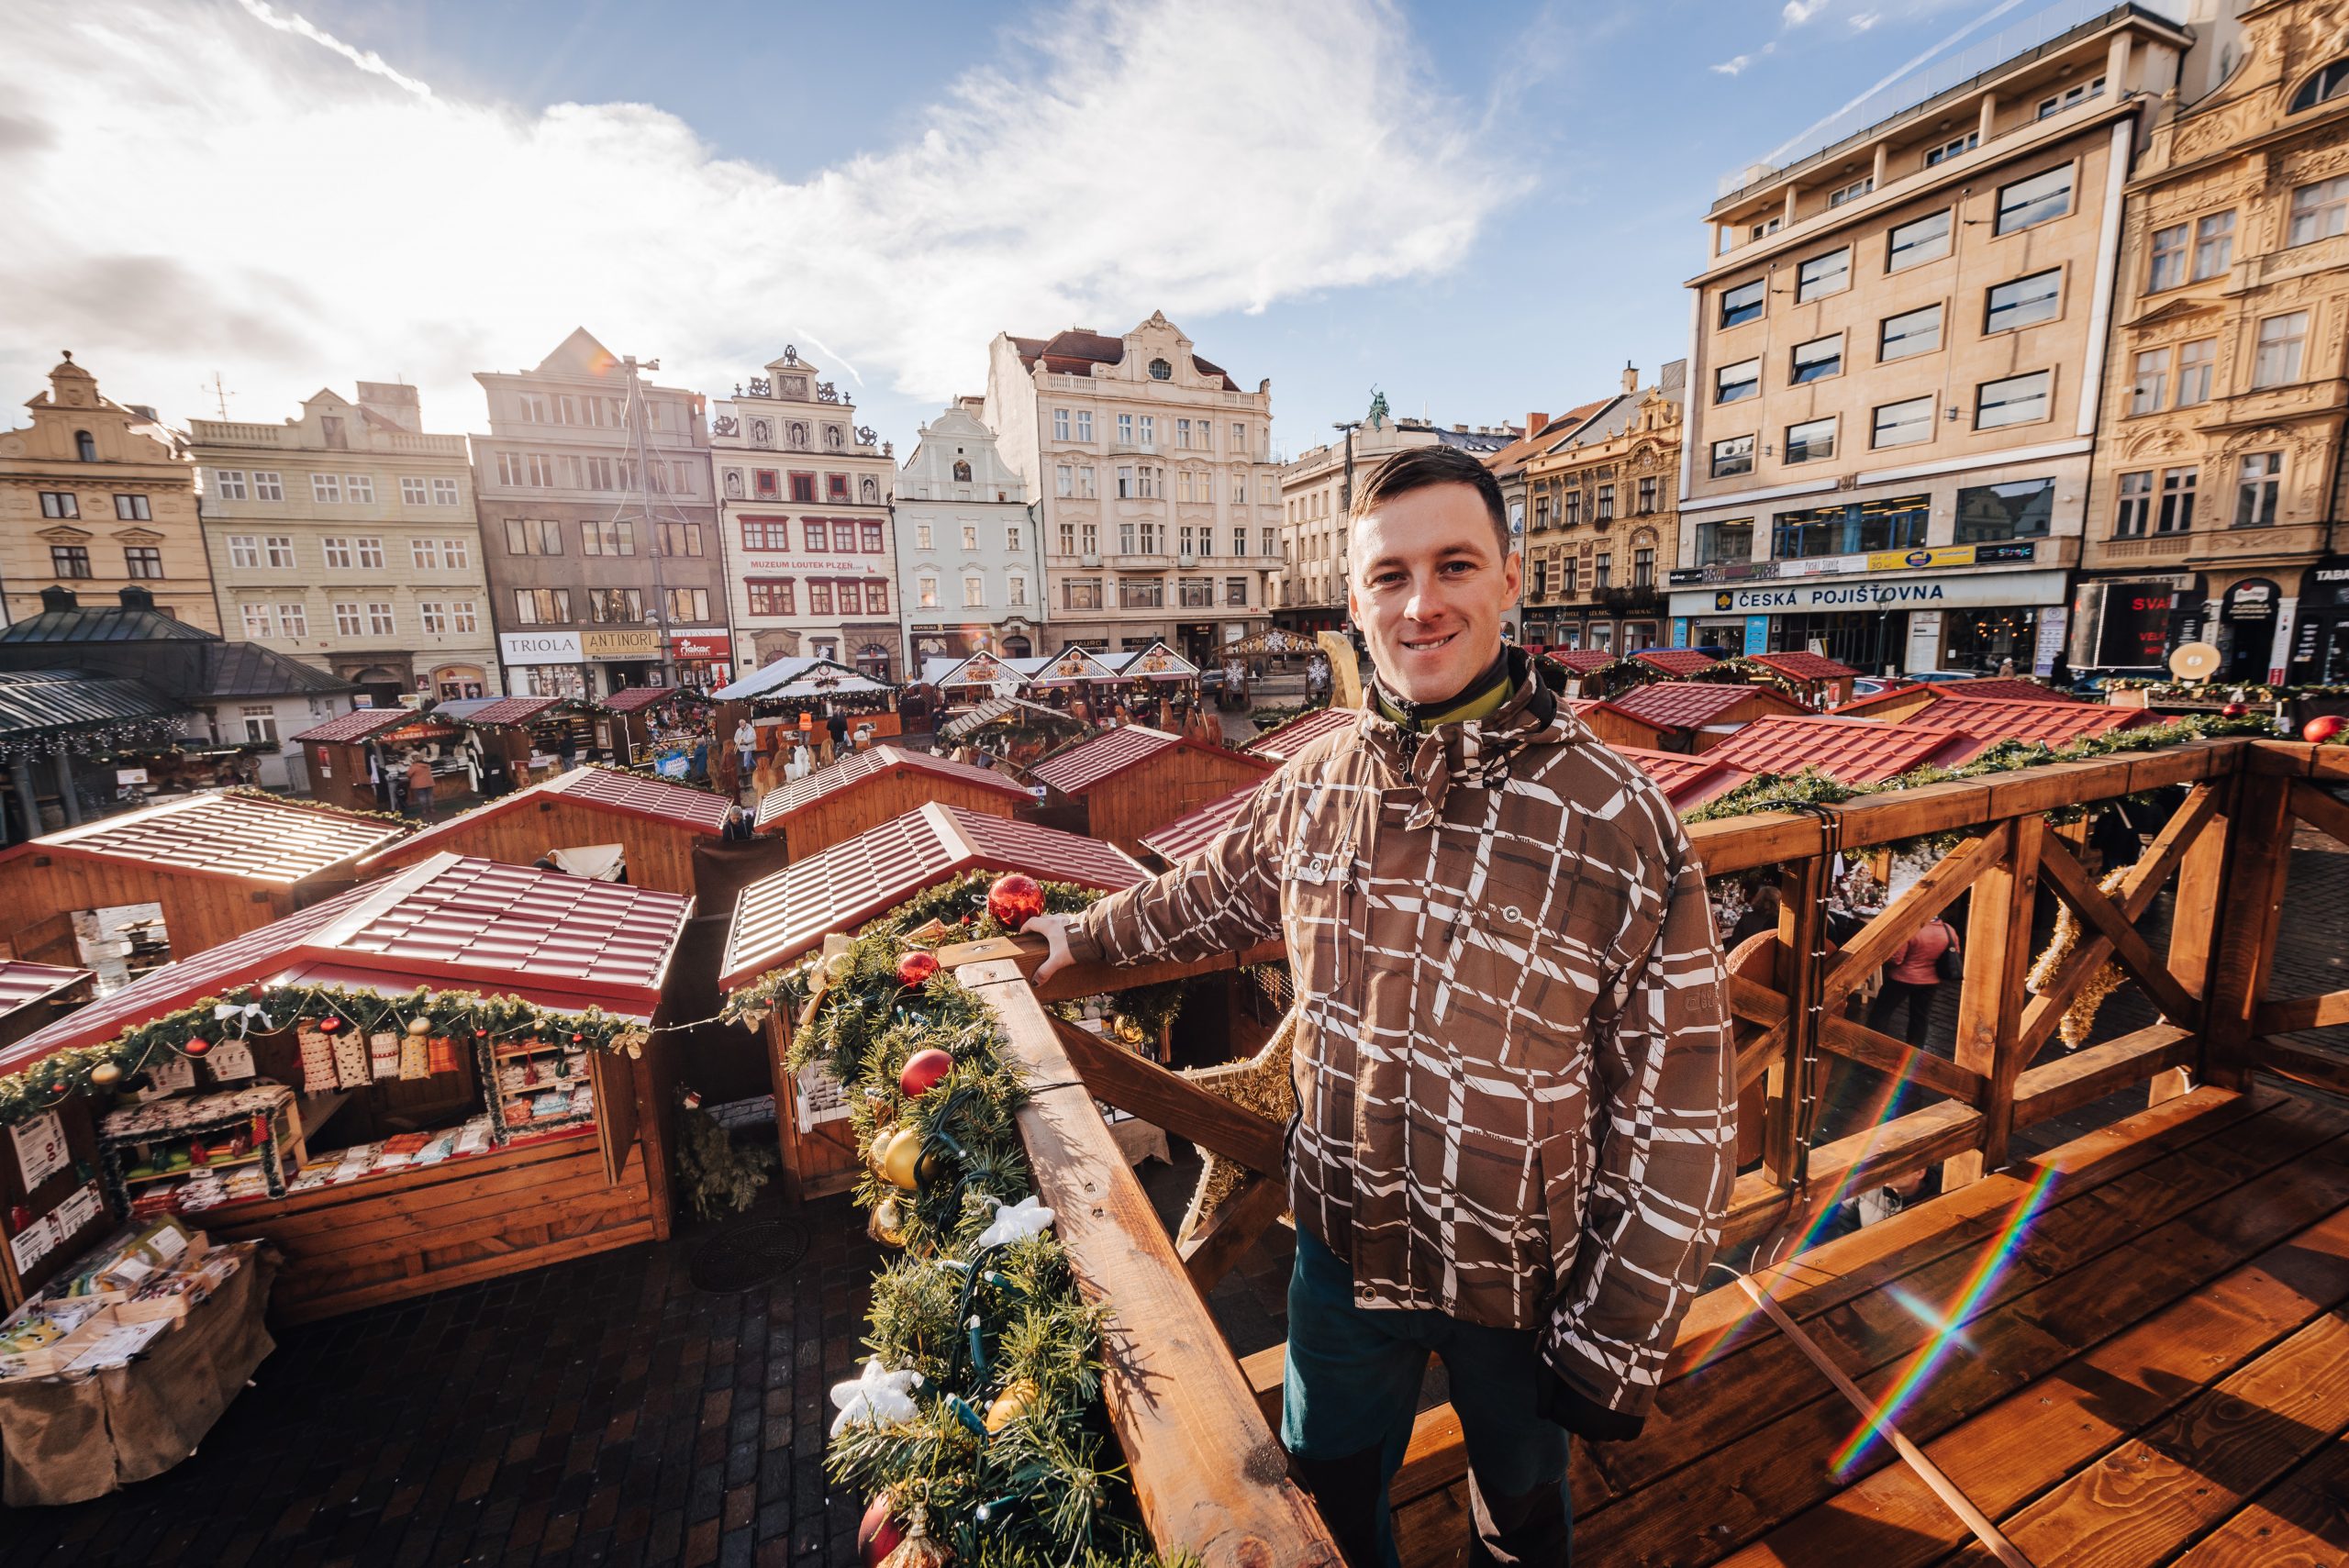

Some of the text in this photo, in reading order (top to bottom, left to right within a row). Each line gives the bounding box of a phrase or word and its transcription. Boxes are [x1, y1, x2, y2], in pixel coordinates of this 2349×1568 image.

[826, 560, 853, 569] PLZEŇ
[1739, 584, 1944, 607] ČESKÁ POJIŠŤOVNA
[509, 639, 574, 652] TRIOLA
[590, 633, 652, 647] ANTINORI
[680, 644, 711, 653] rieker
